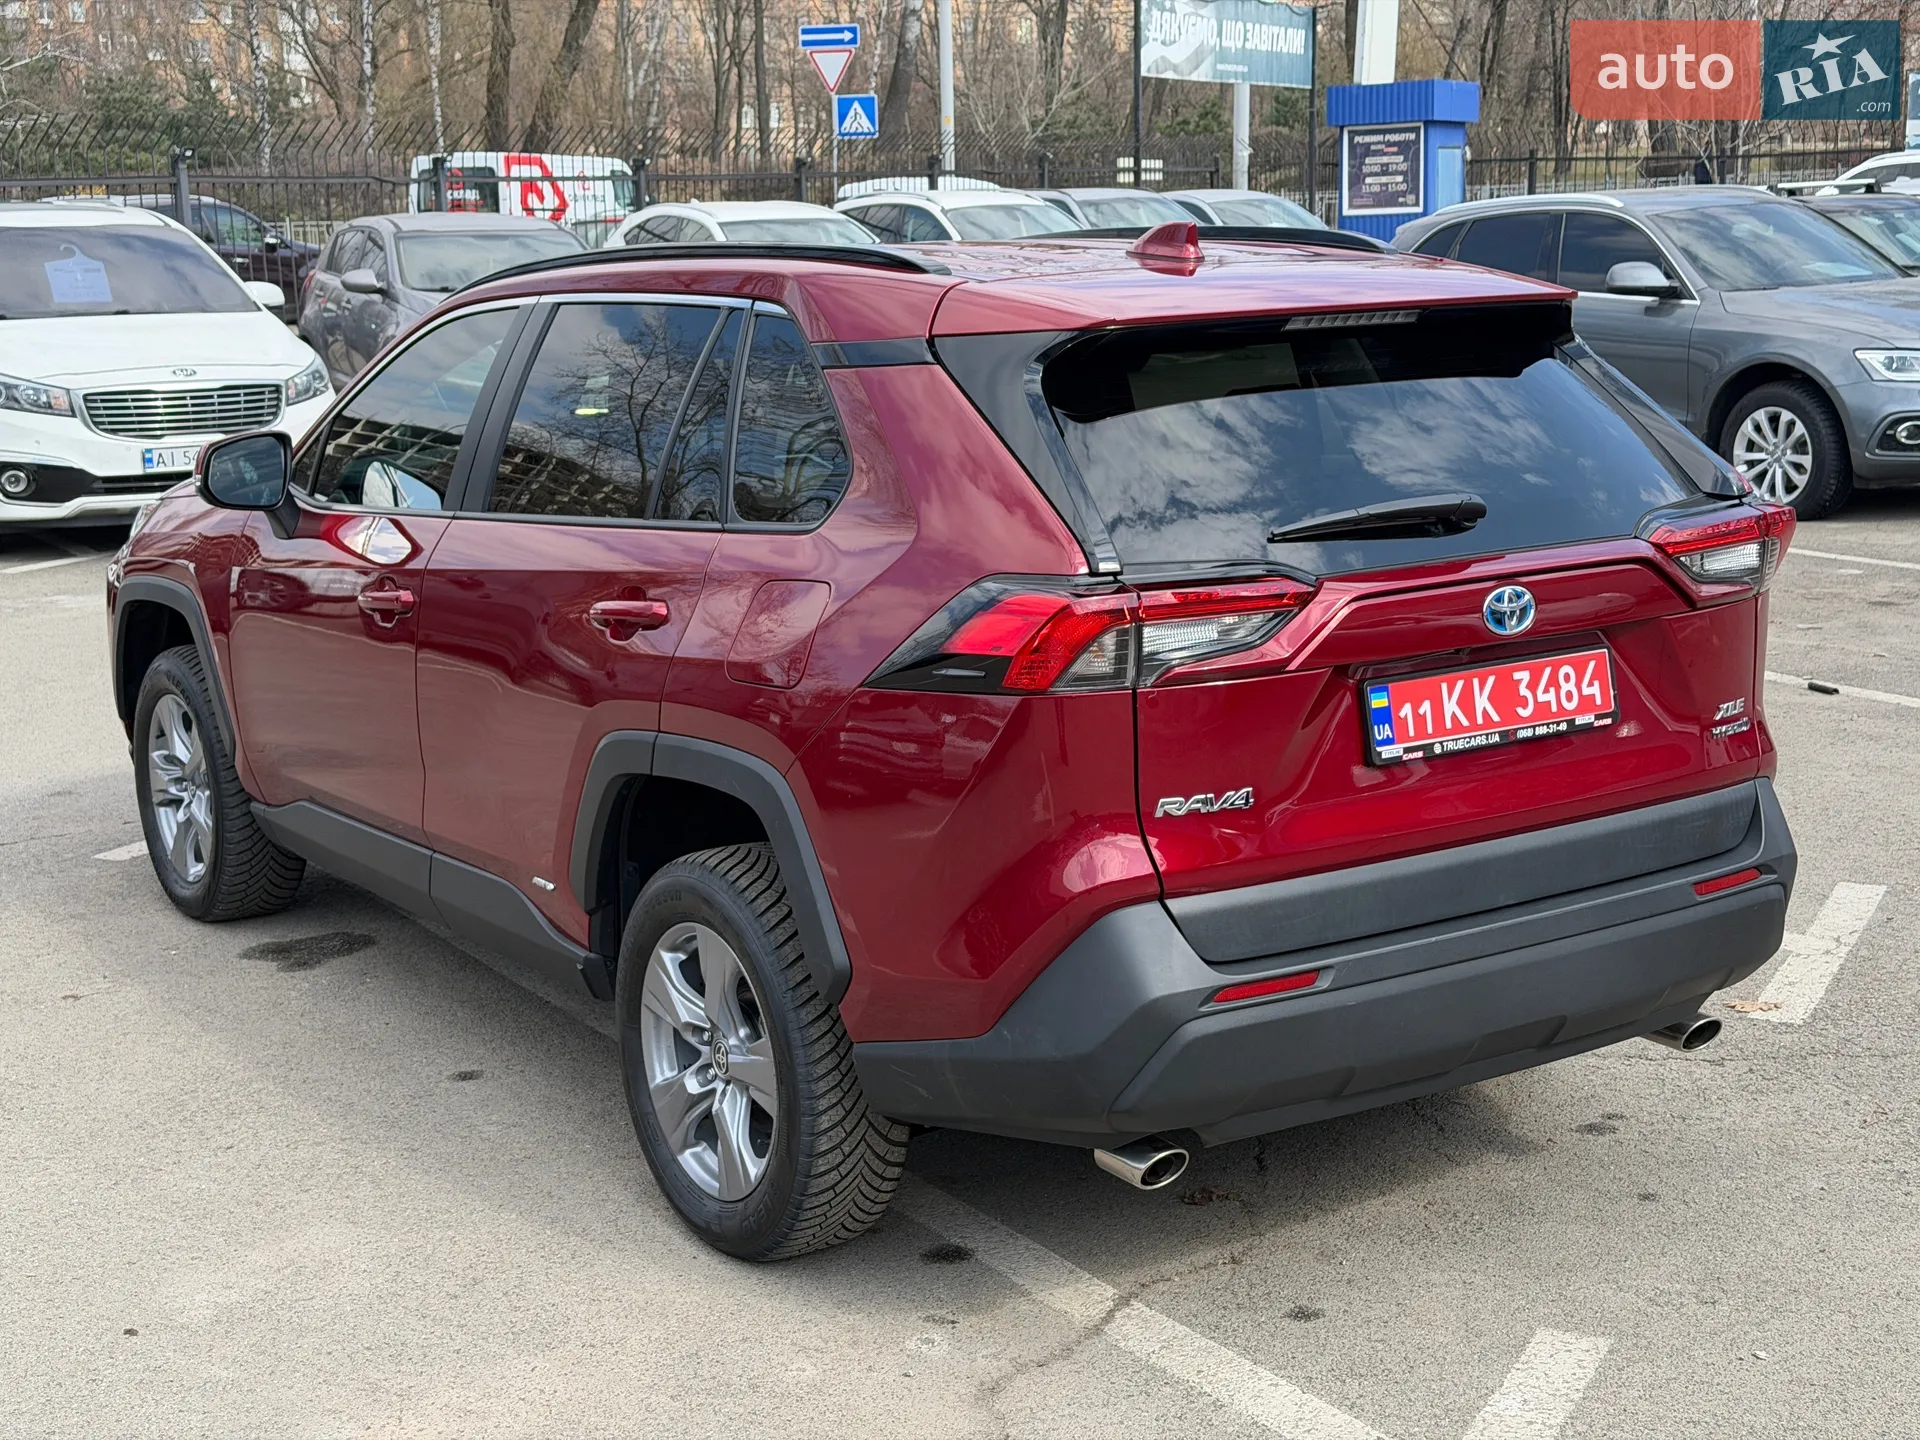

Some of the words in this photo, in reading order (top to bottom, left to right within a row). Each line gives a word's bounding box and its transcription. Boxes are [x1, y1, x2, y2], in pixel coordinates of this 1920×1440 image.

[1149, 11, 1220, 52] ДЯКУЄМО,
[1221, 20, 1245, 53] ЩО
[1245, 23, 1306, 55] ЗАВІТАЛИ!
[1354, 134, 1384, 144] РЕЖИМ
[1384, 132, 1416, 143] РОБОТИ
[1512, 660, 1602, 718] 3484
[1713, 697, 1745, 720] XLE
[1374, 723, 1393, 741] UA
[1442, 732, 1500, 751] TRUECARS.UA
[1154, 787, 1254, 818] RAV4
